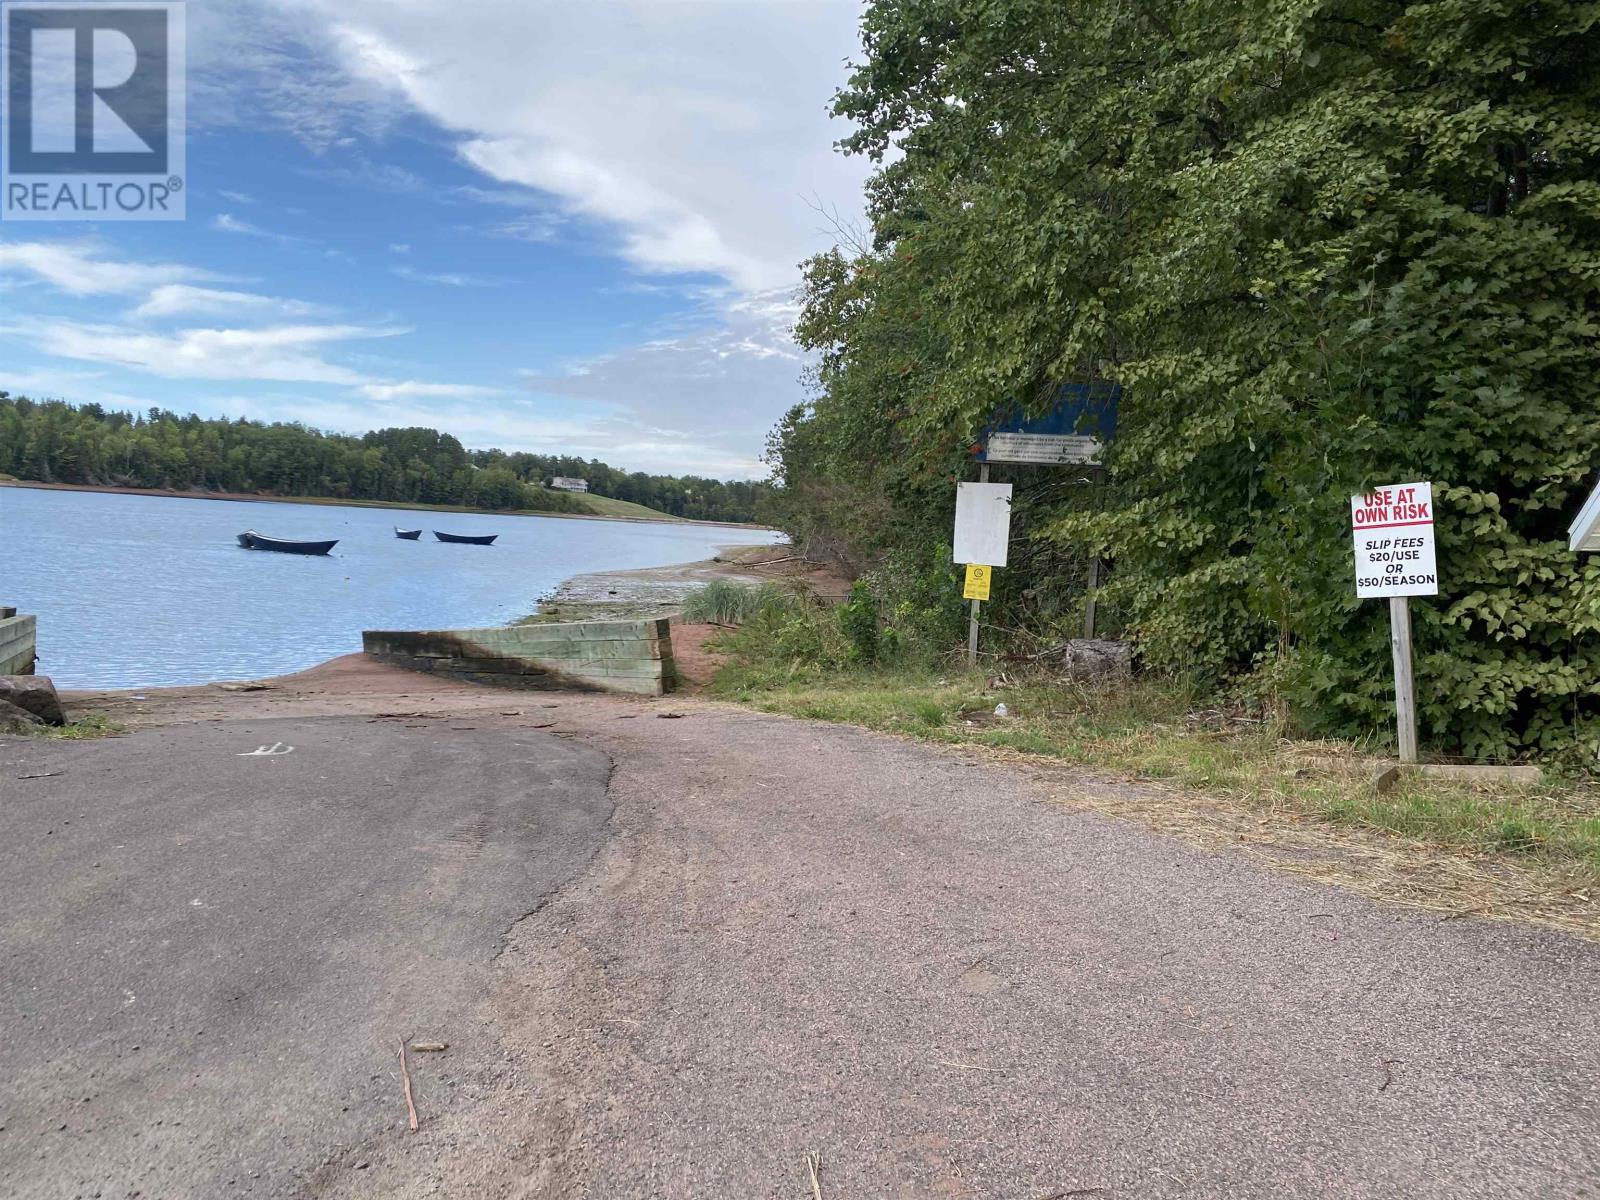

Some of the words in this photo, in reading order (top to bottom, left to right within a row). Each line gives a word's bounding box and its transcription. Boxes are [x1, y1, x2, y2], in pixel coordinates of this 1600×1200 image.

[1363, 490, 1392, 507] USE
[1398, 488, 1415, 504] AT
[1355, 507, 1388, 523] OWN
[1393, 503, 1429, 520] RISK
[1365, 540, 1391, 550] SLIP
[1393, 537, 1424, 549] FEES
[1369, 550, 1420, 562] $20/USE
[1385, 564, 1403, 574] OR
[1358, 575, 1435, 587] $50/SEASON
